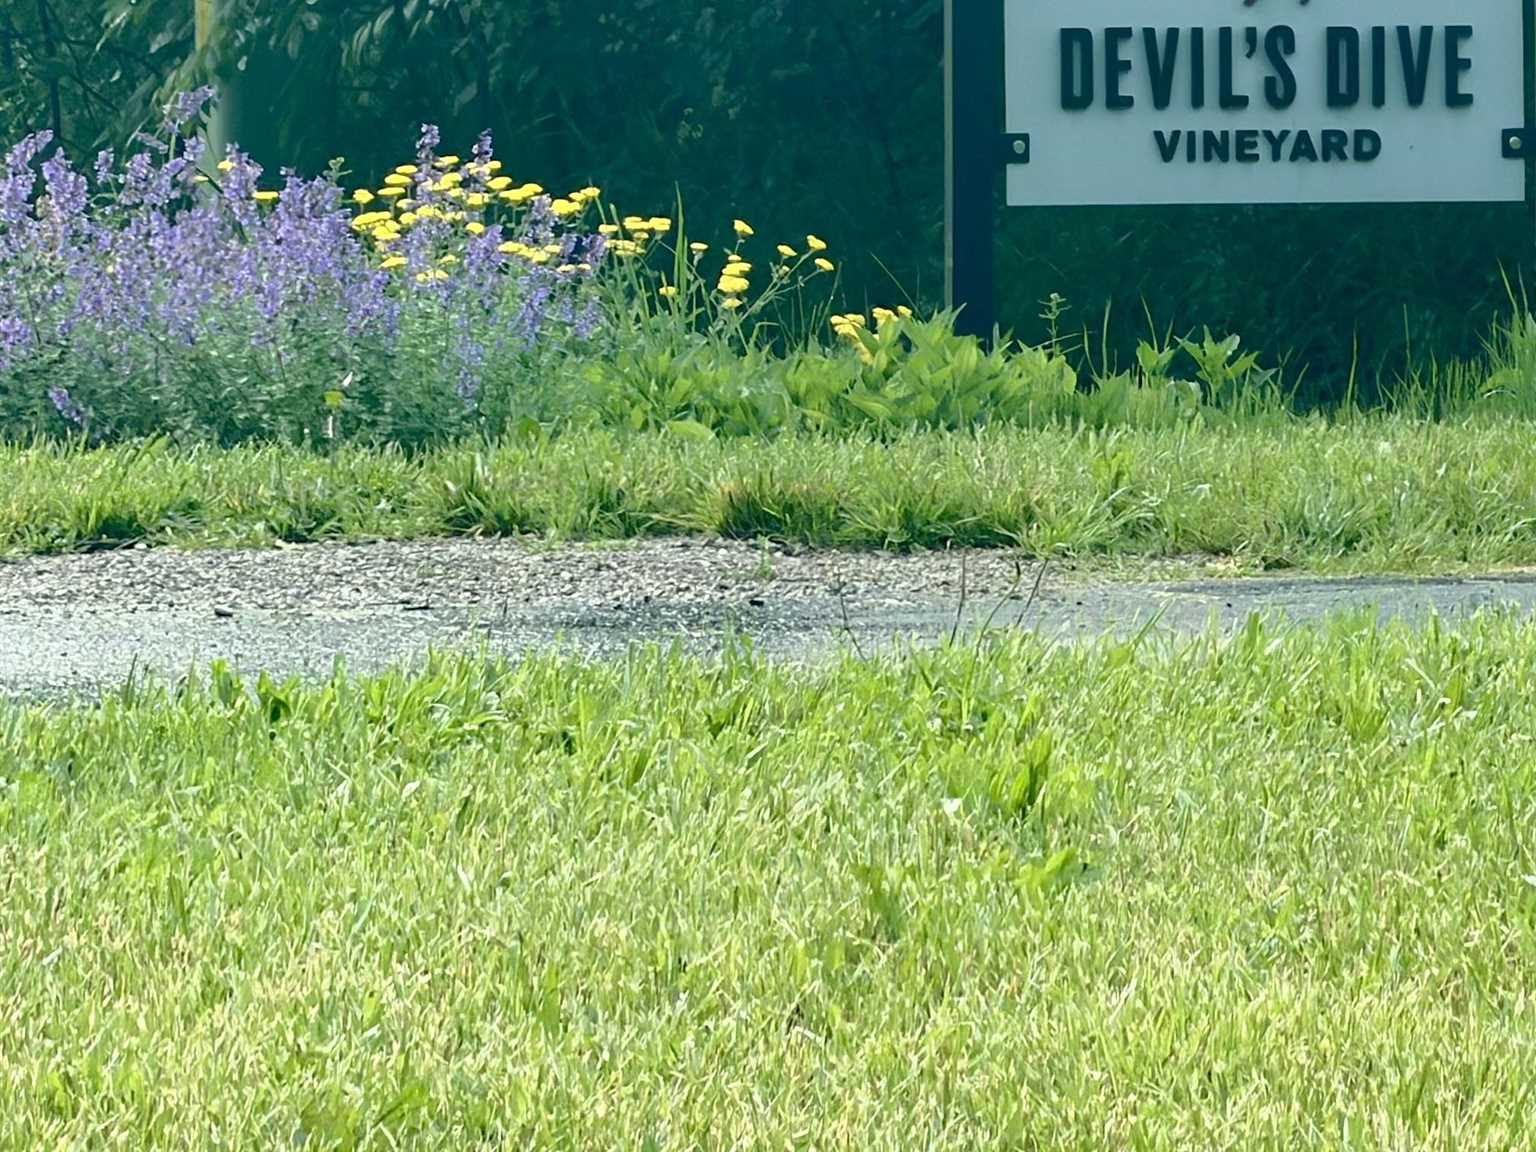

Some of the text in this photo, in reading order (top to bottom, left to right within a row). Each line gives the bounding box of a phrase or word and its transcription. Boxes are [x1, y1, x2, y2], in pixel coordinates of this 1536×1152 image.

[1059, 24, 1474, 110] DEVIL'S DIVE
[1153, 128, 1382, 163] VINEYARD
